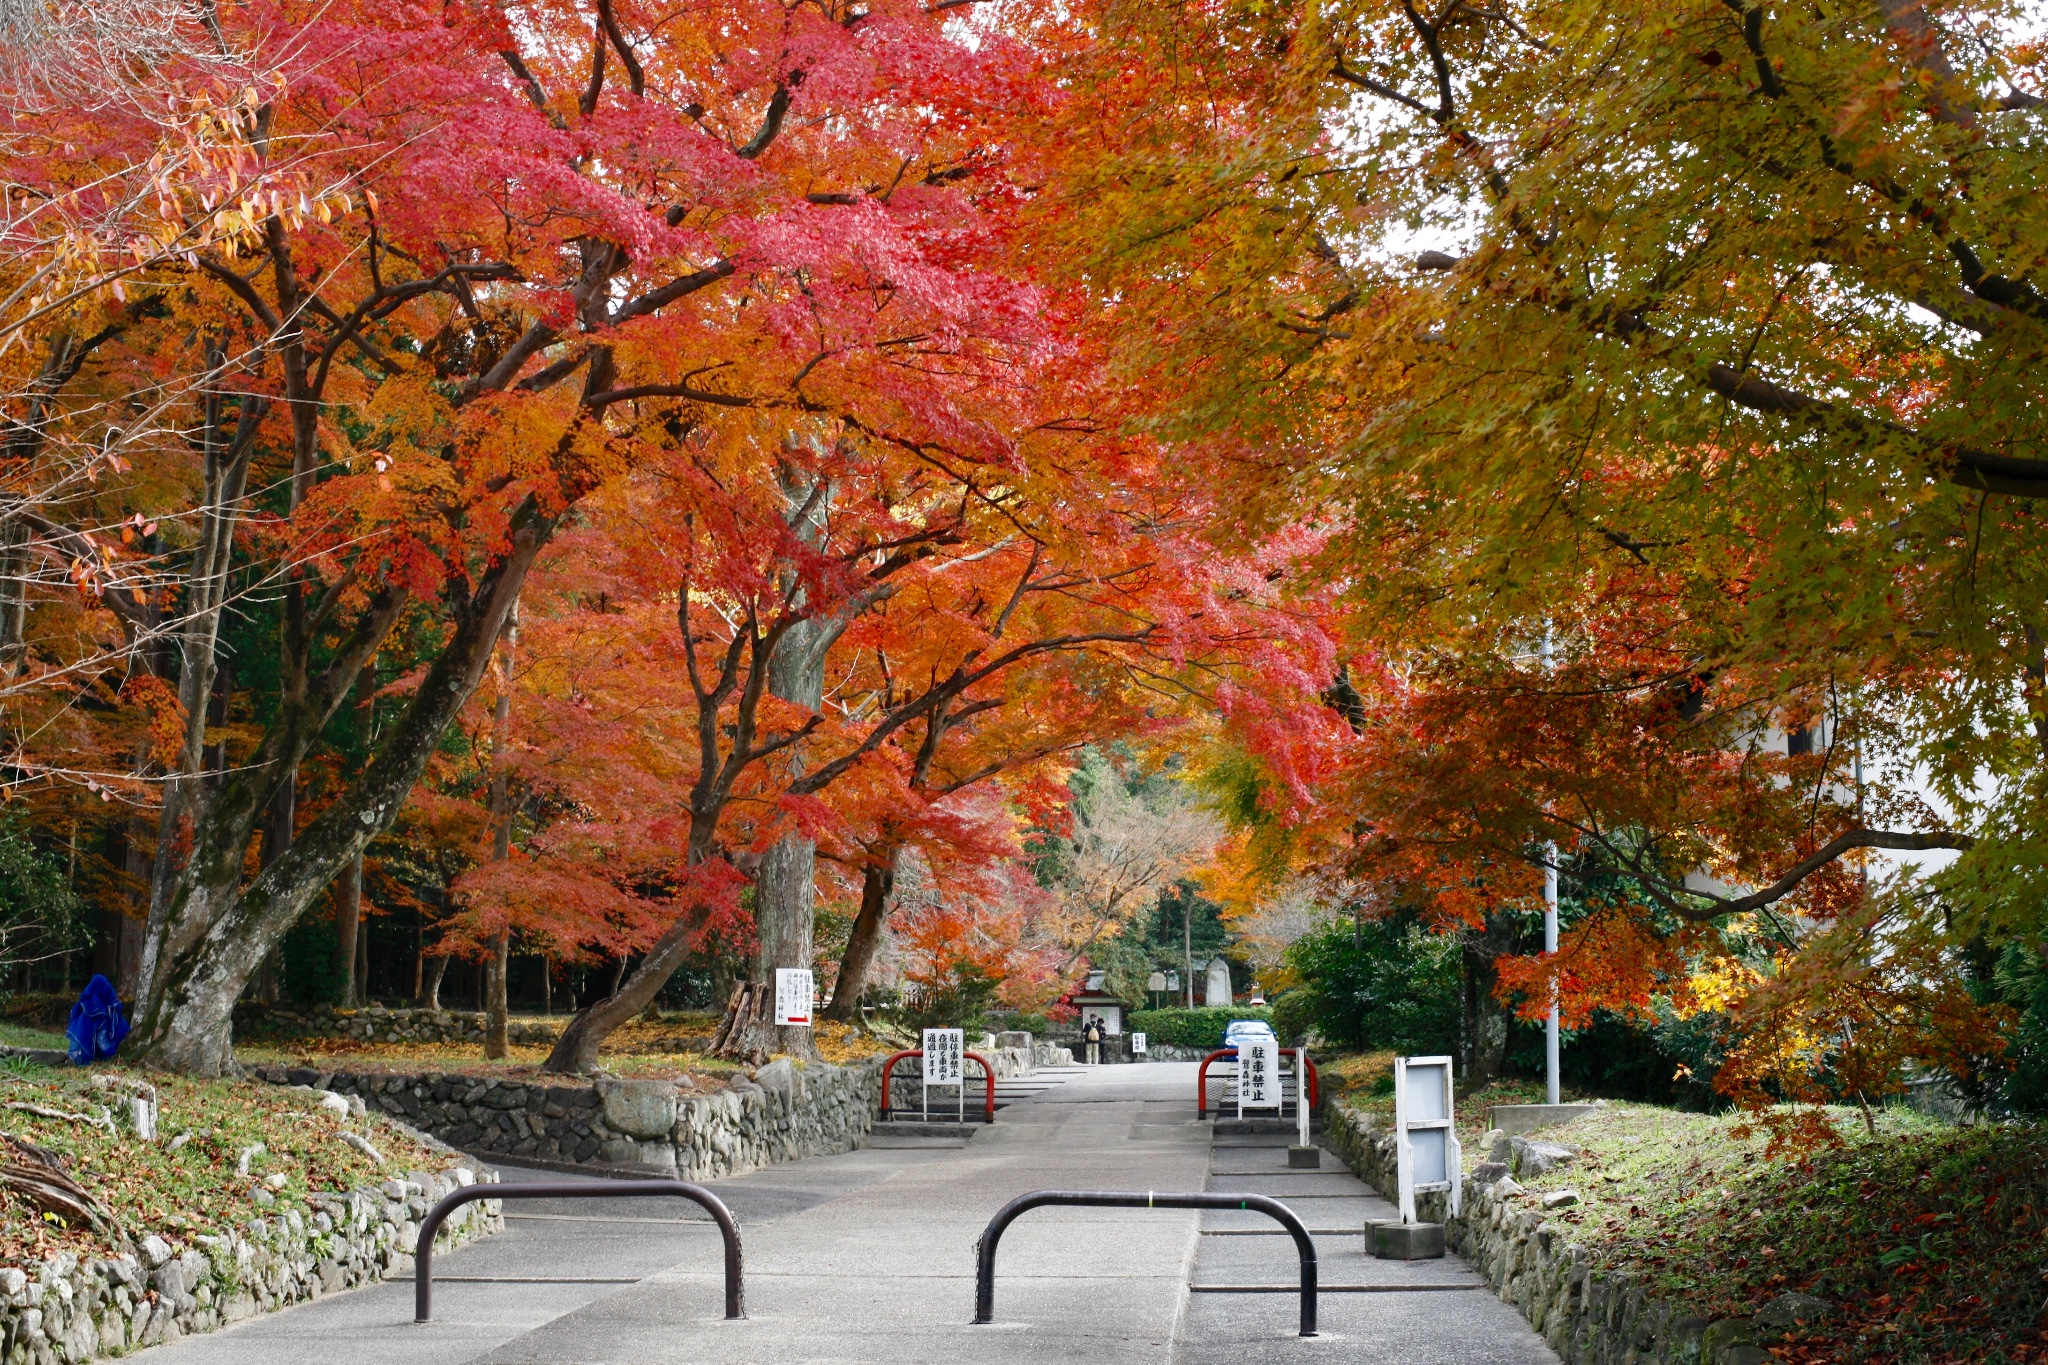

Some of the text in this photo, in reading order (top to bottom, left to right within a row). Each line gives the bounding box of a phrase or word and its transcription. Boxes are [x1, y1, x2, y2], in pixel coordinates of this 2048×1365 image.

[938, 1033, 948, 1081] 夜間も車両が
[949, 1033, 959, 1077] 駐停車禁止
[1242, 1058, 1250, 1097] 鷺森神社
[1251, 1046, 1265, 1102] 駐車禁止
